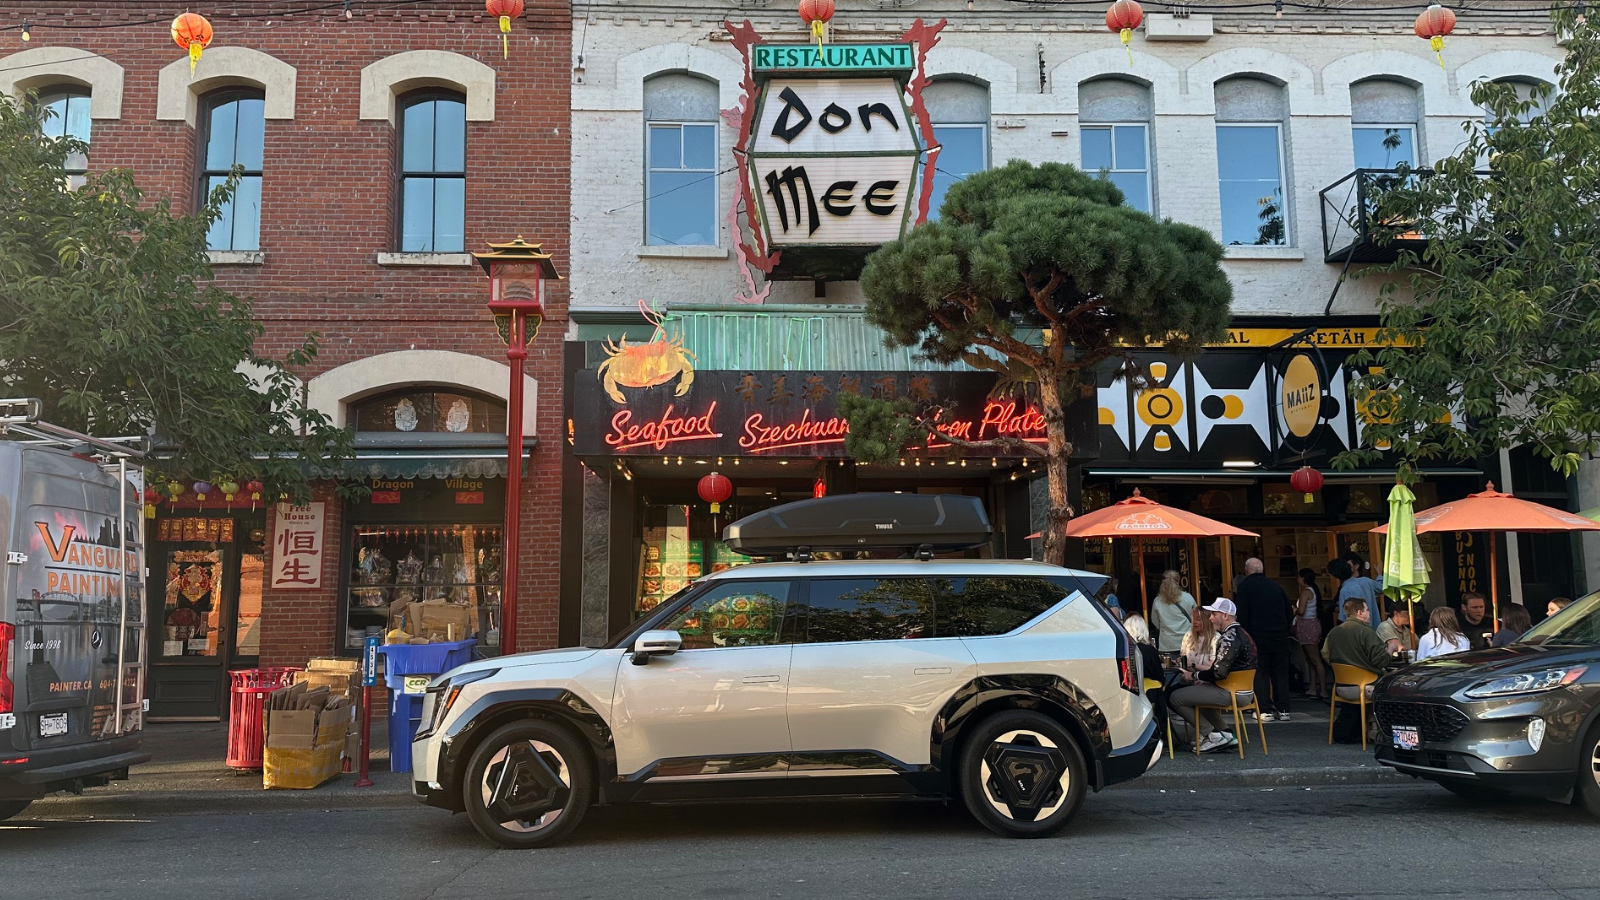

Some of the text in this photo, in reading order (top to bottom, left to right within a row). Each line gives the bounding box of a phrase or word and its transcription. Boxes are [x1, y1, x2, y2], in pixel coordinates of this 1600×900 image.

[757, 47, 909, 67] RESTAURANT
[605, 401, 718, 450] Seafood
[739, 408, 850, 447] Szechuan
[978, 402, 1047, 438] Plate
[372, 479, 483, 490] Dragon Village
[289, 504, 312, 512] Free
[276, 528, 319, 585] 恒生
[1179, 549, 1189, 588] 540
[48, 572, 121, 598] PAINTIN
[24, 640, 61, 650] Since 1998
[49, 680, 93, 692] PAINTER.CA
